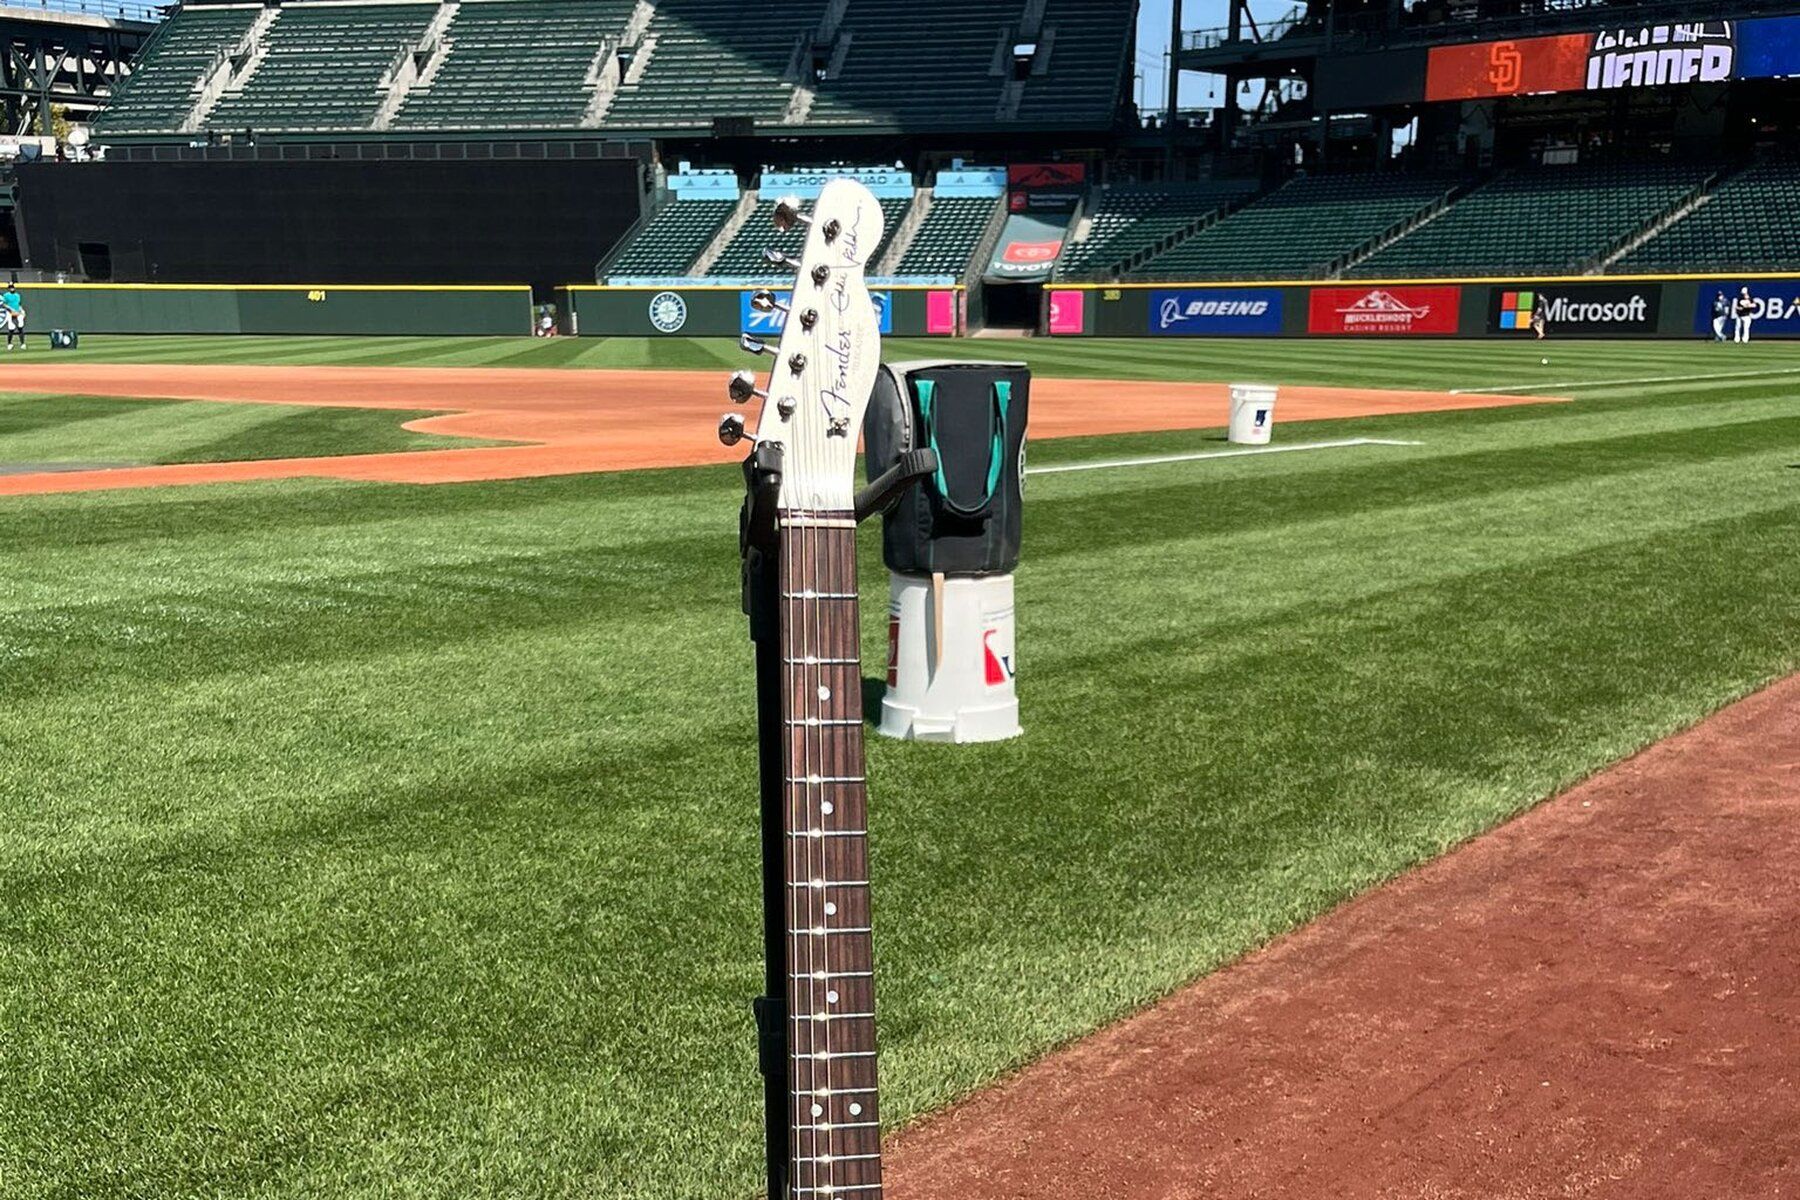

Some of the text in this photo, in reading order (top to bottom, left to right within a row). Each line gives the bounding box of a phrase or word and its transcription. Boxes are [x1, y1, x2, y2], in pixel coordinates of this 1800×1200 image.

[307, 290, 326, 301] 401
[1185, 301, 1268, 316] BOEING
[1542, 295, 1647, 323] Microsoft
